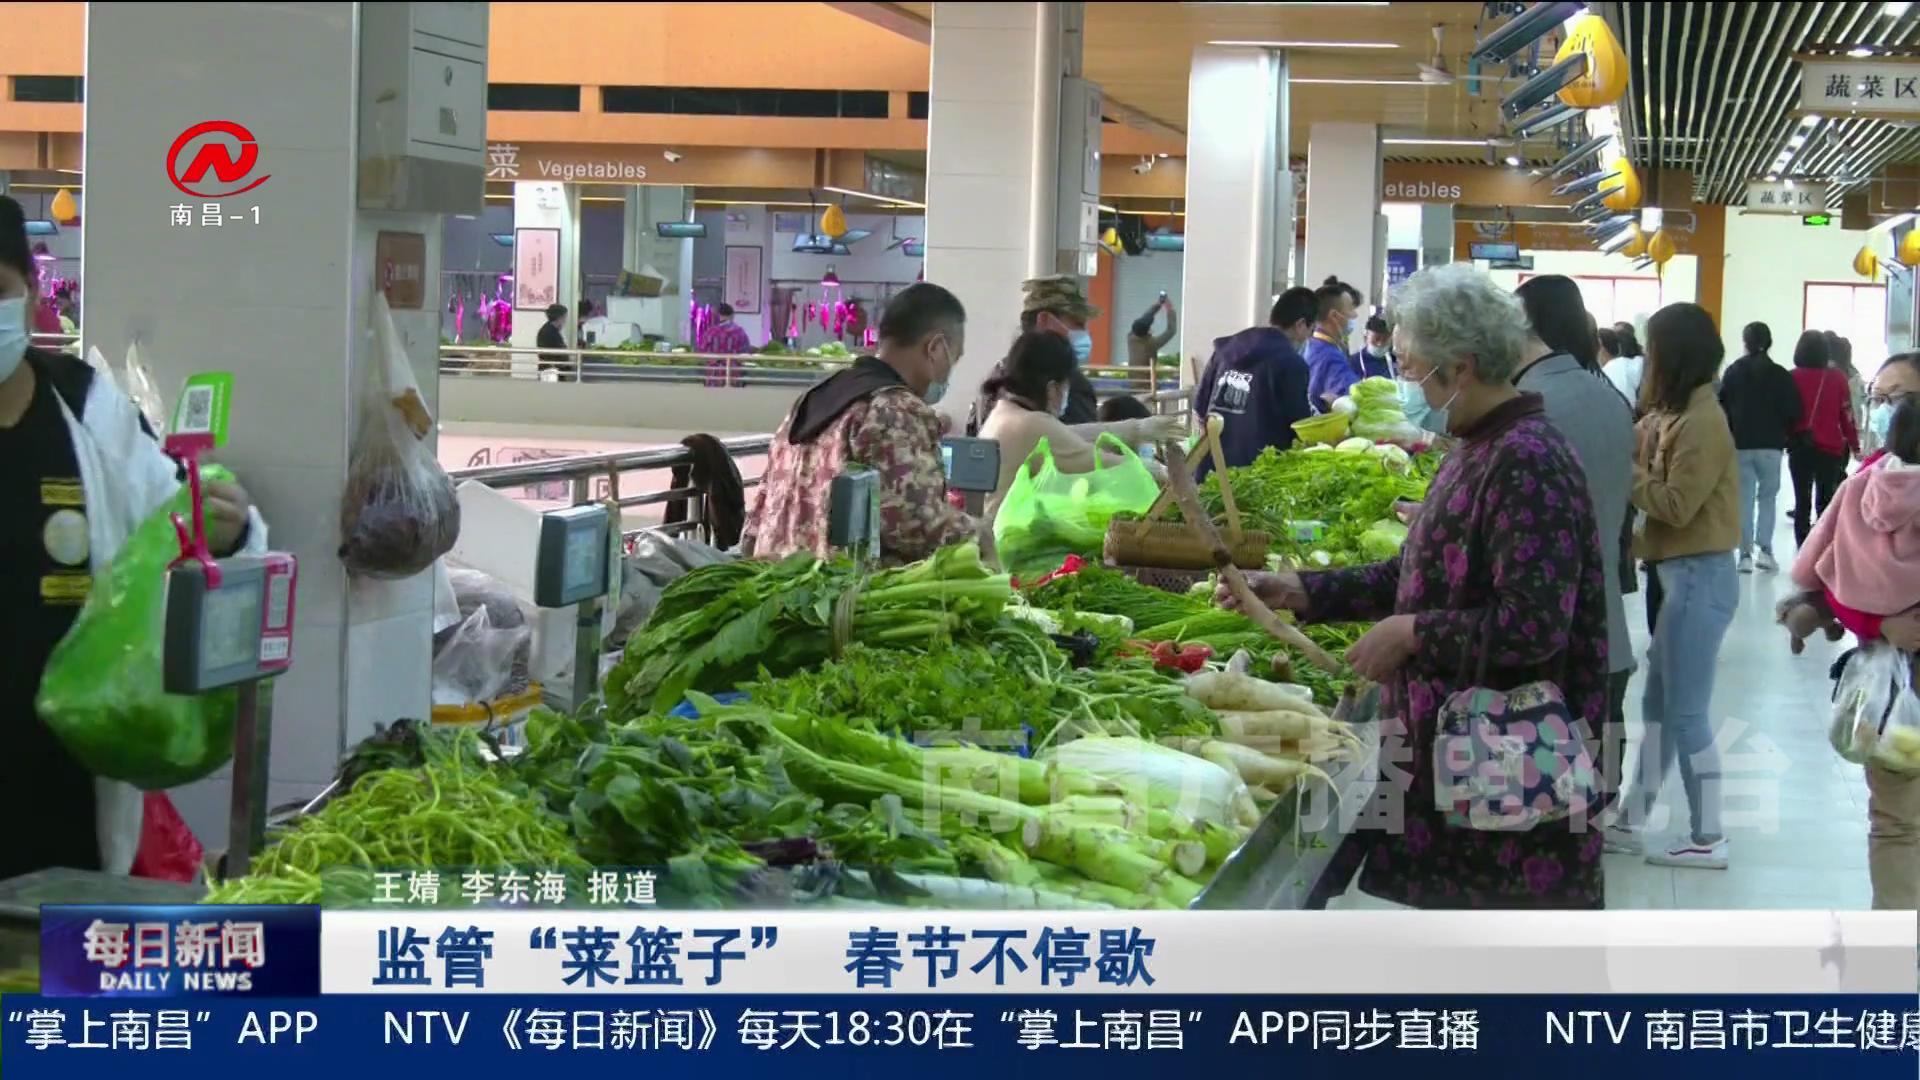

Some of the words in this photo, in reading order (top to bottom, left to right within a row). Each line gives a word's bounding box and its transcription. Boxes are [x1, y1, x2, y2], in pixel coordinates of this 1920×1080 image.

[1825, 73, 1919, 98] 蔬菜区
[487, 143, 520, 178] 菜
[538, 159, 647, 180] Vegetables
[1760, 190, 1813, 204] 蔬菜区
